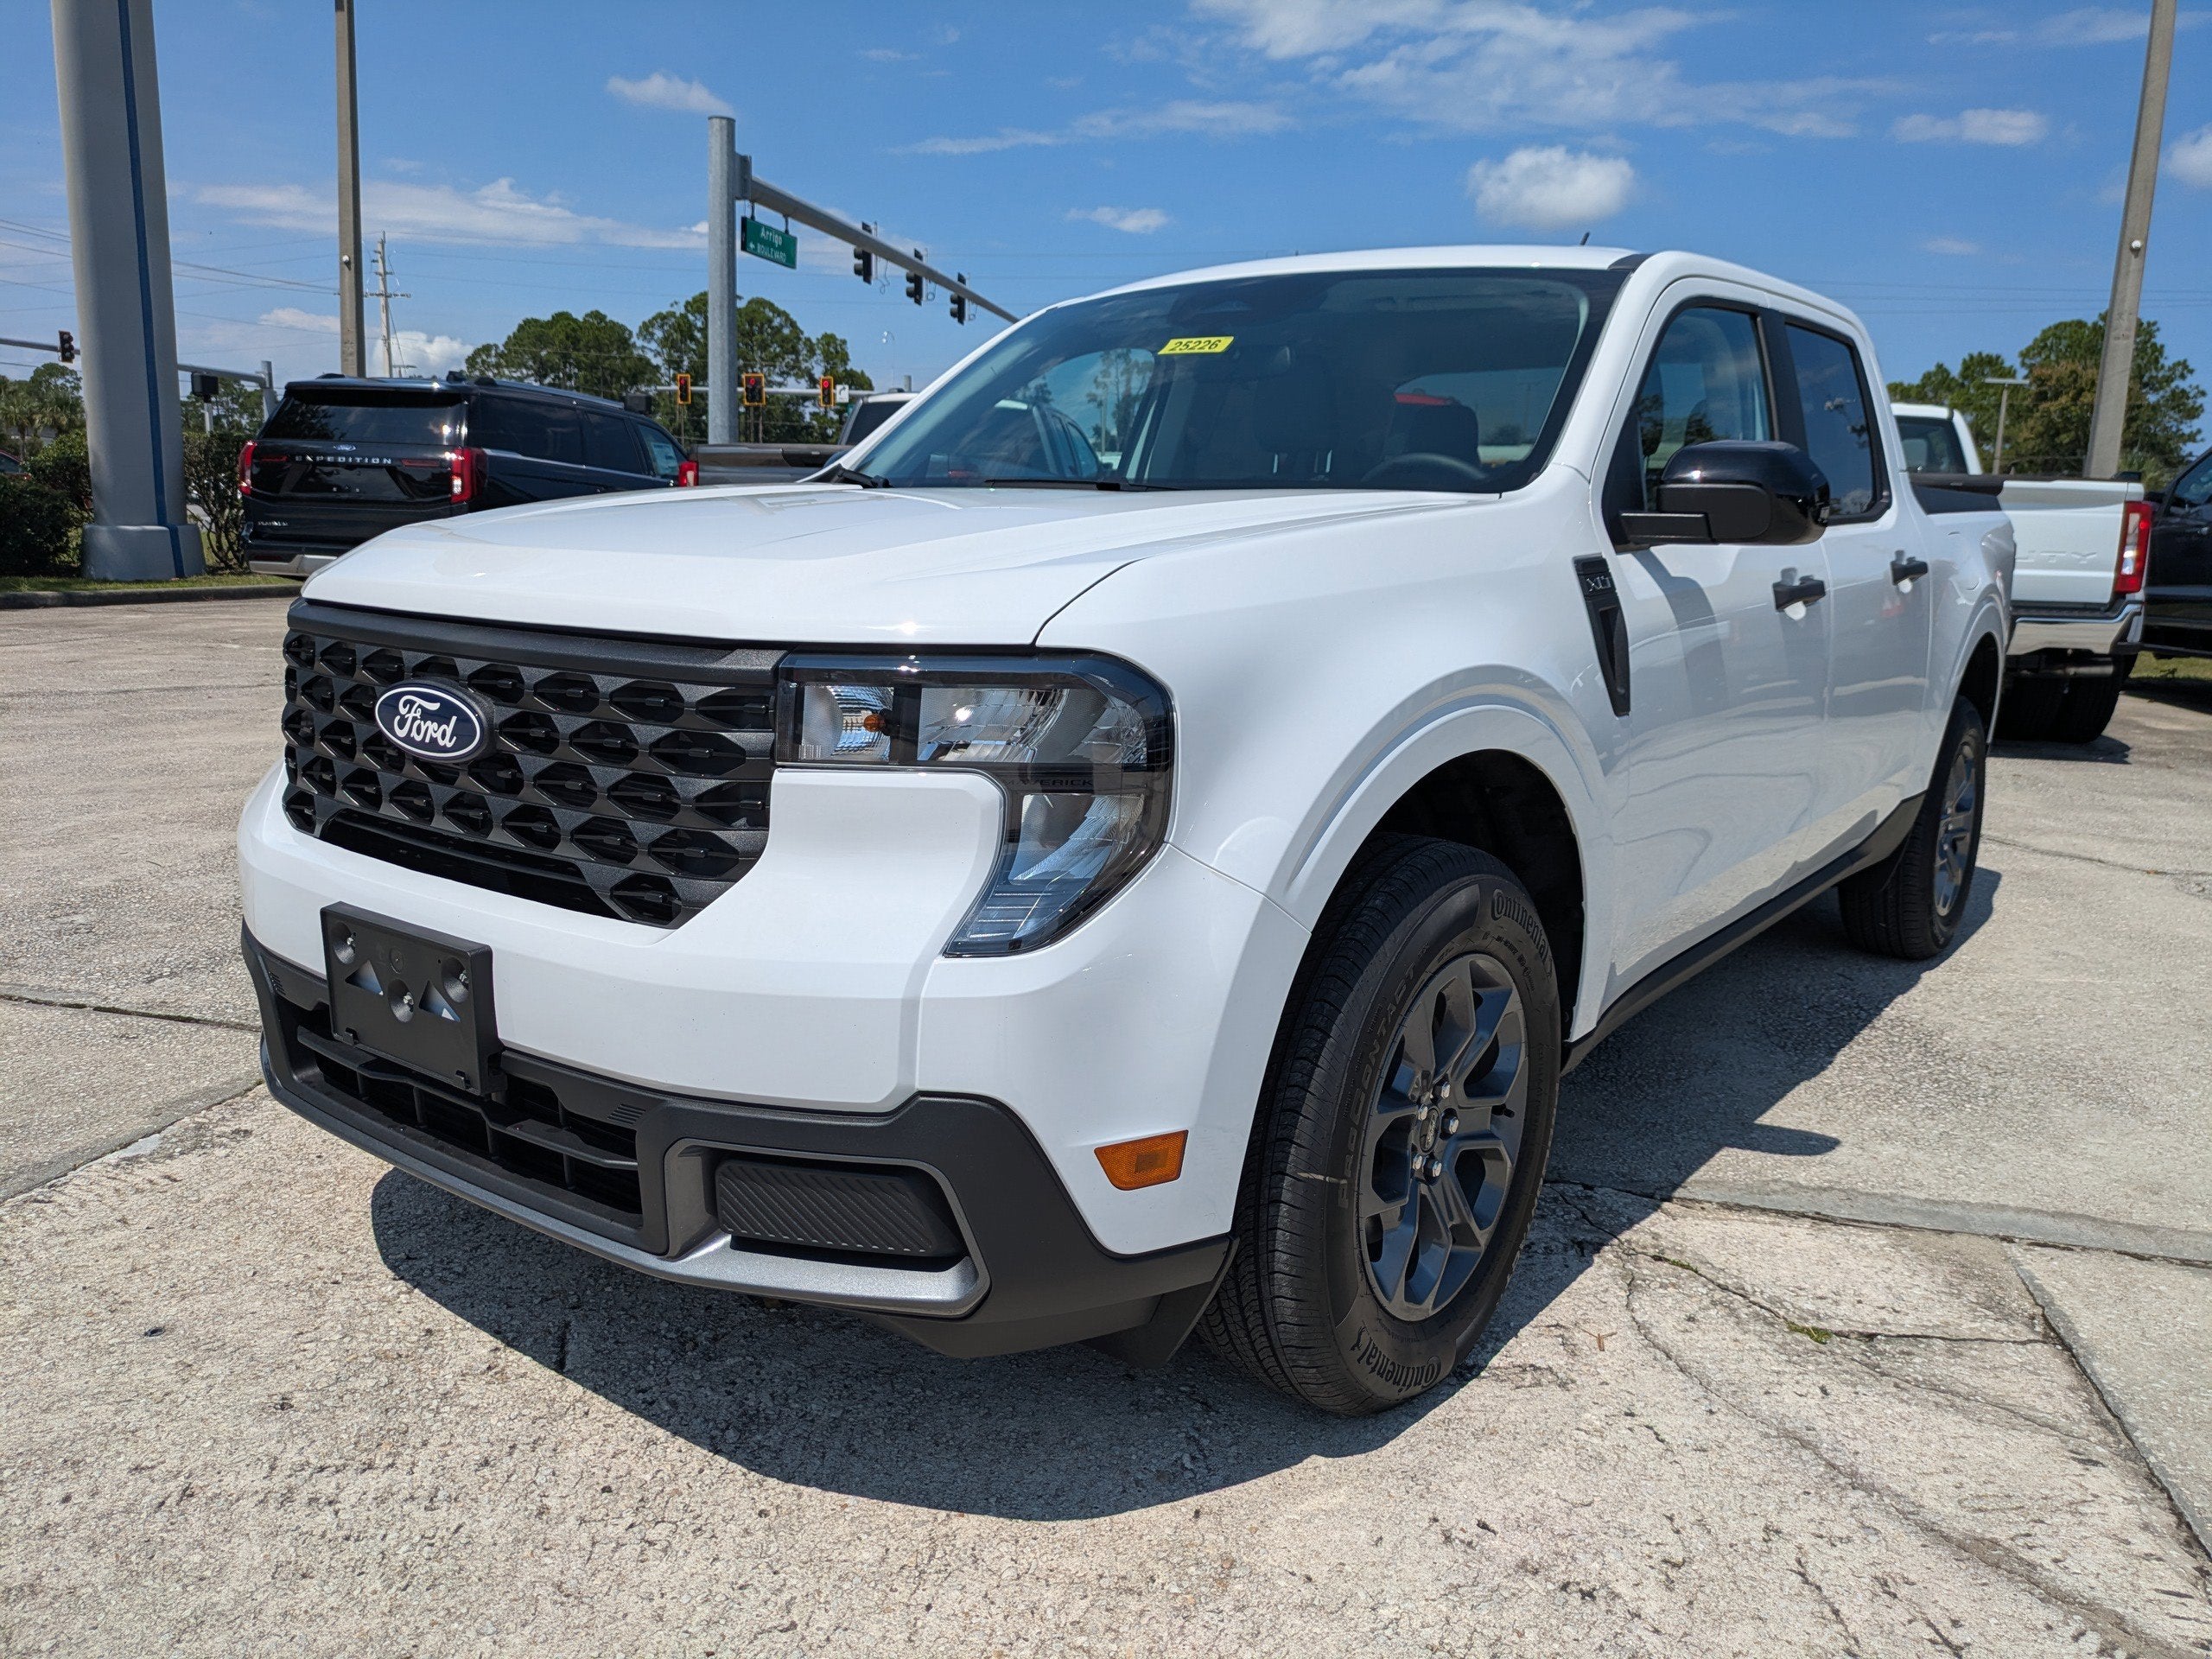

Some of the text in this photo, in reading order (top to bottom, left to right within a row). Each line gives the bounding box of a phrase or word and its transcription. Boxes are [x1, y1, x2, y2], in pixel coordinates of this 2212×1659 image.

[760, 226, 783, 247] Arrigo
[757, 243, 787, 262] BOULEVARD
[1168, 340, 1221, 352] 25226
[295, 454, 392, 465] EXPEDITION
[2015, 550, 2097, 564] UTY
[393, 695, 457, 748] Ford
[1491, 888, 1551, 965] Continental
[1357, 1337, 1442, 1392] Continental
